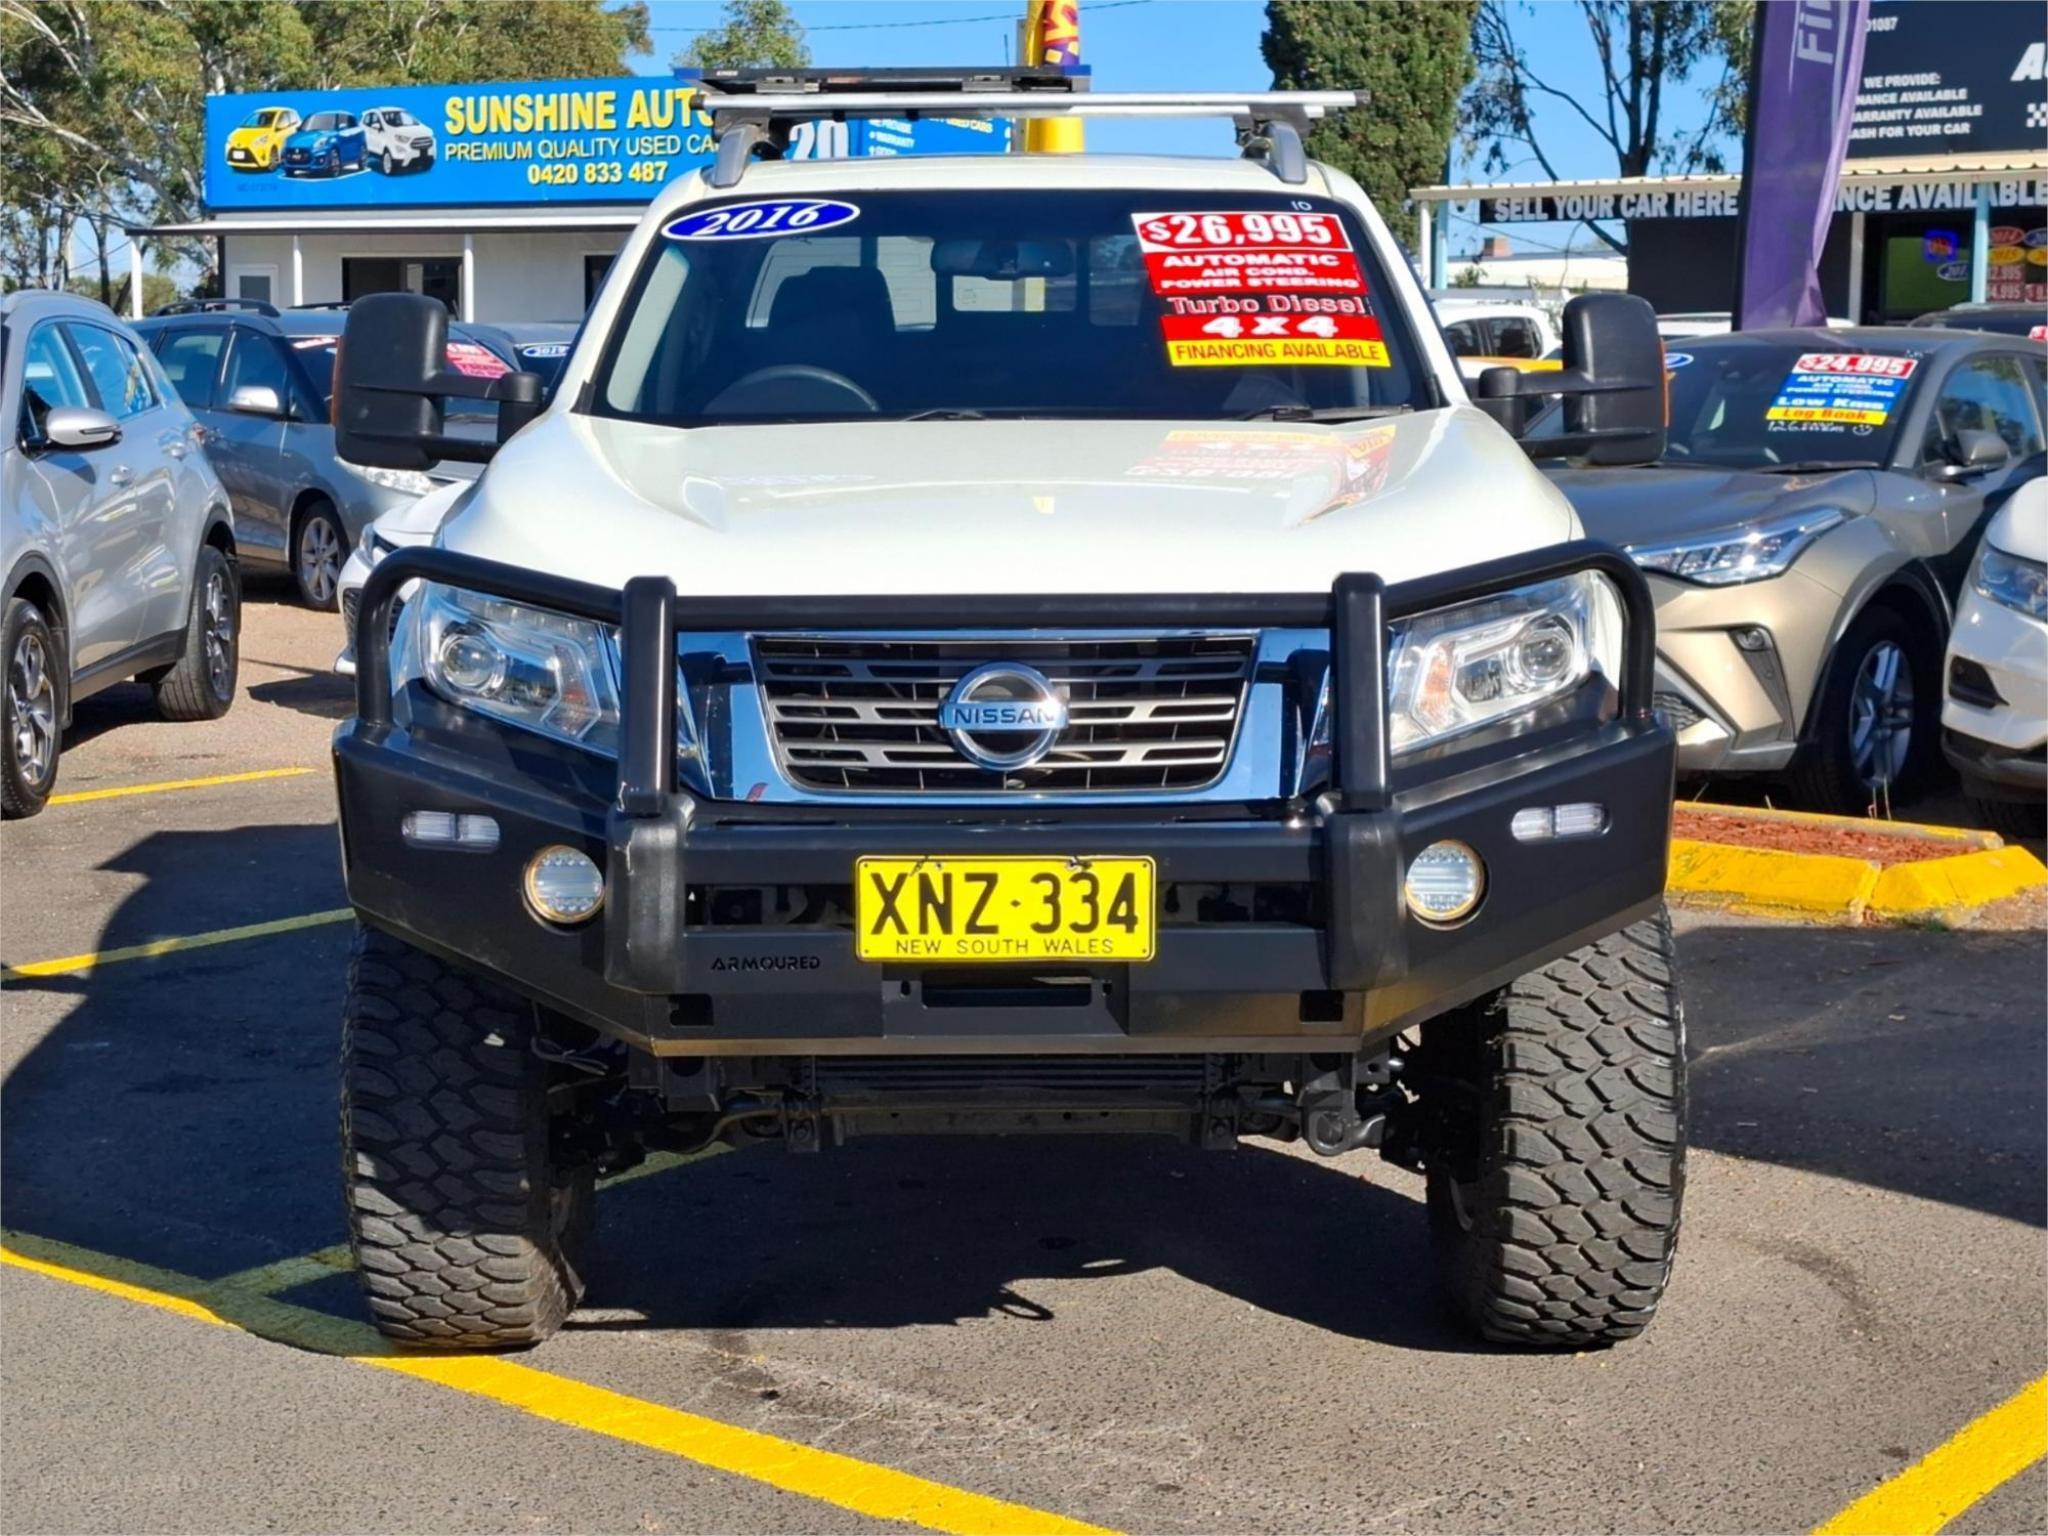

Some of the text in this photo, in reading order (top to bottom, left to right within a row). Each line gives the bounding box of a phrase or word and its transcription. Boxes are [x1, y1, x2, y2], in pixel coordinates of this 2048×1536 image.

[2010, 42, 2047, 81] A
[1864, 72, 1941, 88] WE PROVIDE:
[1856, 88, 1967, 105] NANCE AVAILABLE
[444, 90, 617, 134] SUNSHINE
[1914, 104, 1983, 119] AVAILABLE
[1879, 126, 1904, 138] FOR
[1907, 124, 1941, 137] YOUR
[1944, 122, 1970, 135] CAR
[445, 133, 720, 161] PREMIUM QUALITY USED CA
[527, 160, 668, 184] 0420 833 487
[1495, 188, 1740, 221] SELL YOUR CAR HERE
[1833, 185, 1893, 212] NCE
[691, 203, 830, 236] 2016
[1146, 214, 1333, 245] $26,995
[1163, 254, 1340, 268] AUTOMATIC
[1201, 267, 1315, 277] AIR COND.
[1161, 277, 1360, 289] POWER STEERING
[1167, 294, 1366, 315] Turbo Diesel
[1176, 342, 1381, 361] FINANCING AVAILABLE
[1797, 375, 1895, 386] AUTOMATIC
[1778, 396, 1826, 407] Low
[1783, 408, 1867, 421] Log Book
[954, 708, 1055, 724] NISSAN
[896, 938, 1114, 954] NEW SOUTH WALES
[711, 956, 820, 970] ARMOURED
